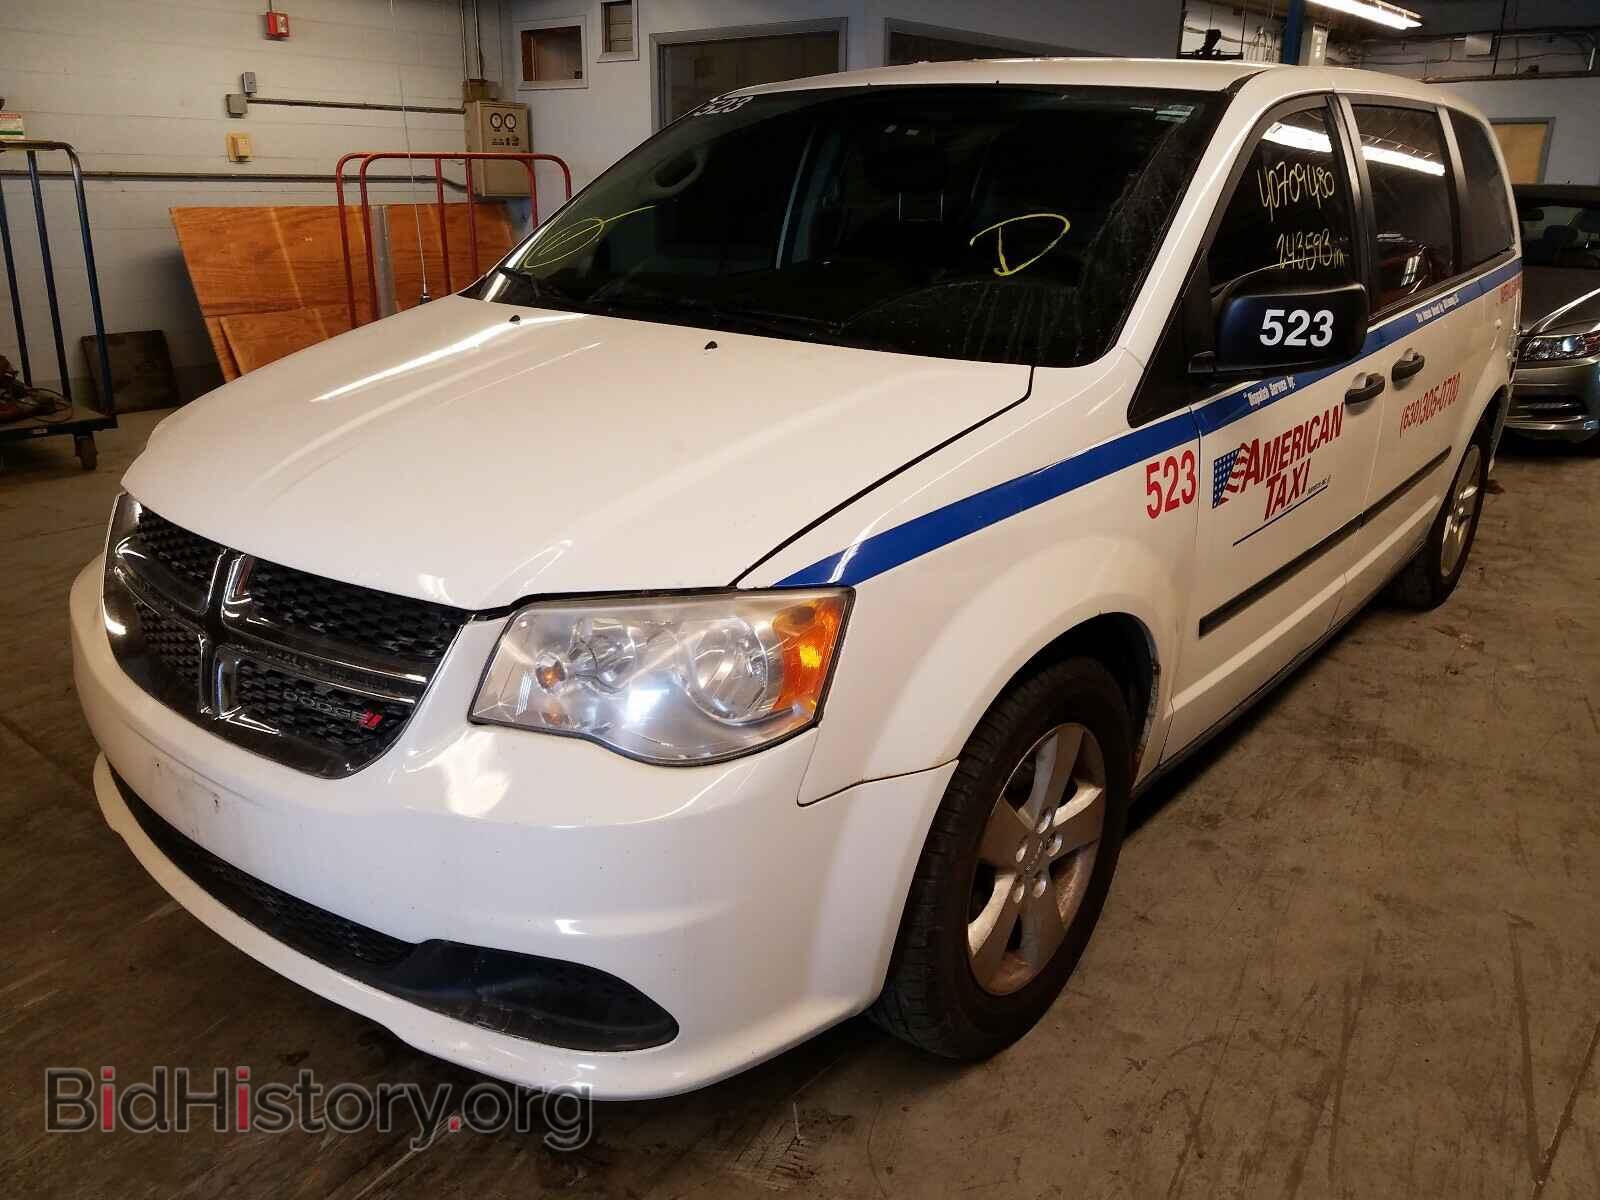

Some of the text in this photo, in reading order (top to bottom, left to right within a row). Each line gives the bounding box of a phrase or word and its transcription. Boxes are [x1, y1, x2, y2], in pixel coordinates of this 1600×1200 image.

[1257, 161, 1335, 222] 40709480
[1260, 309, 1334, 347] 523
[1241, 401, 1344, 493] AMERICAN
[1146, 450, 1196, 519] 523
[1264, 458, 1311, 521] TAXI
[283, 690, 367, 722] DODGE
